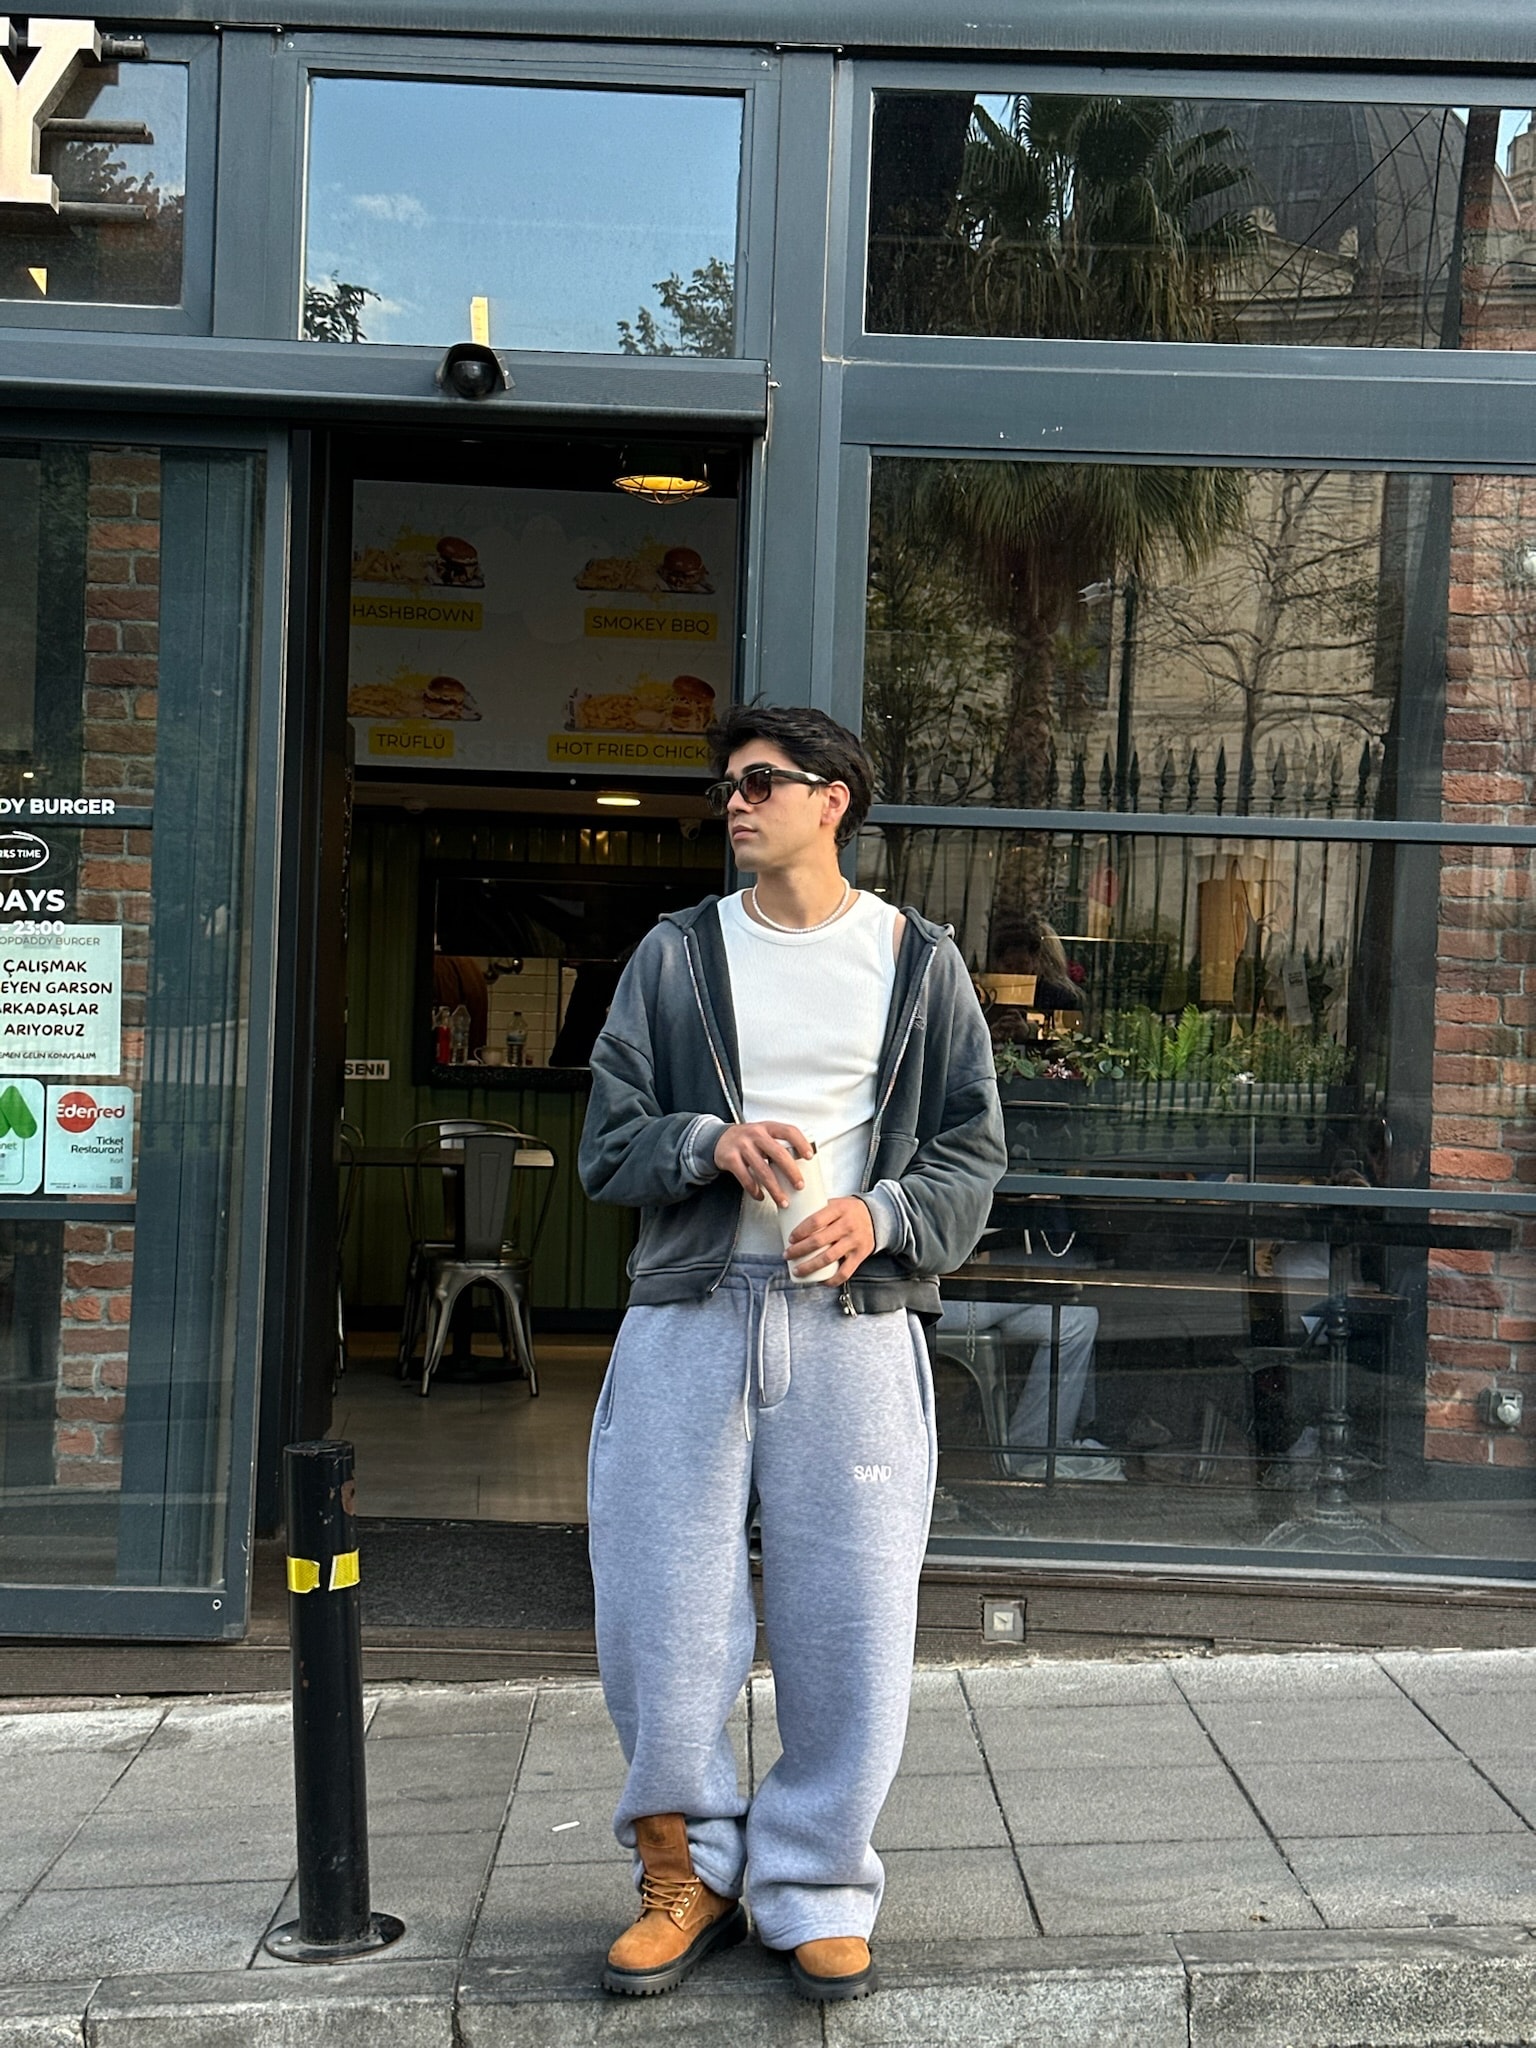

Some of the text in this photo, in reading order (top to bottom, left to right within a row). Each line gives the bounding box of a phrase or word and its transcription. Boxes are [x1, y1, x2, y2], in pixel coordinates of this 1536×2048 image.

[352, 604, 475, 623] HASHBROWN
[592, 615, 710, 635] SMOKEY BBQ
[376, 732, 445, 750] TRÜFLÜ
[556, 742, 593, 756] HOT
[597, 743, 649, 757] FRIED
[30, 798, 116, 815] BURGER
[17, 849, 41, 859] TIME
[0, 888, 66, 912] AYS
[12, 919, 65, 936] 23:00
[56, 936, 101, 946] BURGER
[3, 959, 87, 978] ÇALIŞMAK
[1, 981, 113, 994] EYEN GARSON
[0, 1002, 99, 1017] RKADAŞLAR
[4, 1023, 85, 1037] ARIYORUZ
[57, 1103, 125, 1119] Edenred
[96, 1136, 124, 1146] Ticket
[71, 1144, 124, 1154] Restaurant
